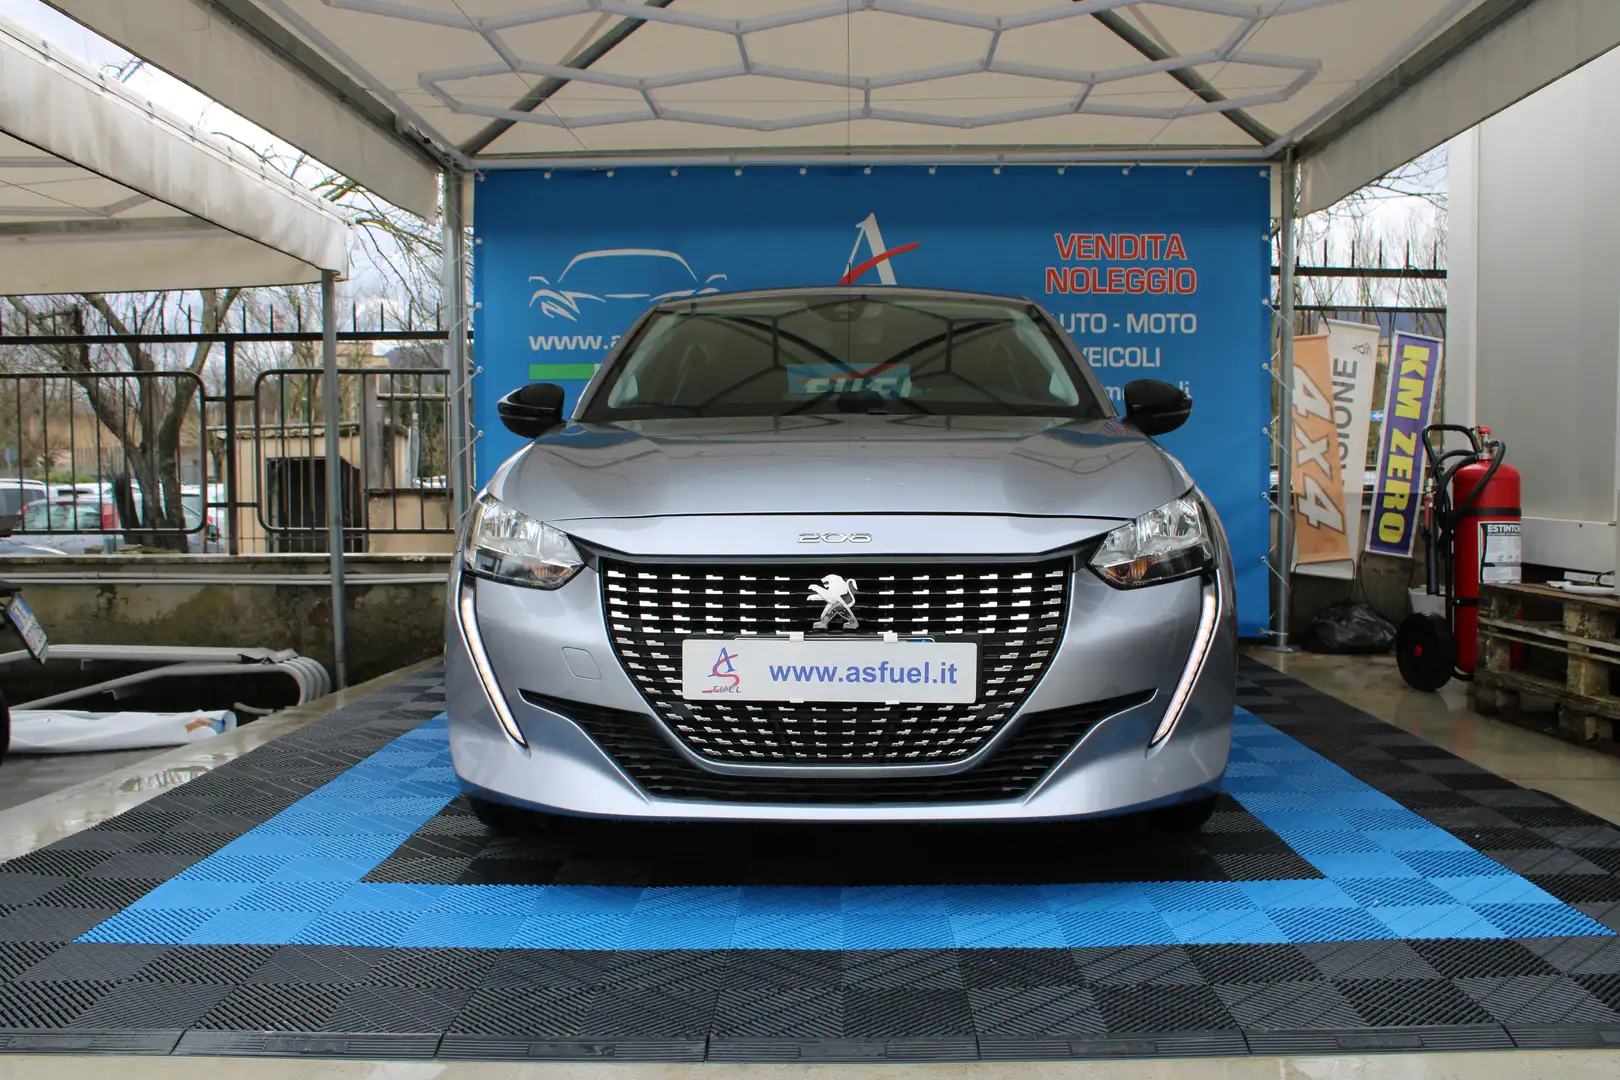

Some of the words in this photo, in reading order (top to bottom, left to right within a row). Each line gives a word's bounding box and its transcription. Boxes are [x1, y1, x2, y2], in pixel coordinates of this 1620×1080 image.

[1054, 233, 1187, 261] VENDITA
[1045, 266, 1198, 295] NOLEGGIO
[1057, 313, 1107, 334] UTO
[1126, 313, 1197, 334] MOTO
[1395, 344, 1430, 419] KM
[1378, 432, 1417, 543] ZERO
[796, 532, 873, 543] 208
[769, 661, 957, 684] www.asfuel.it
